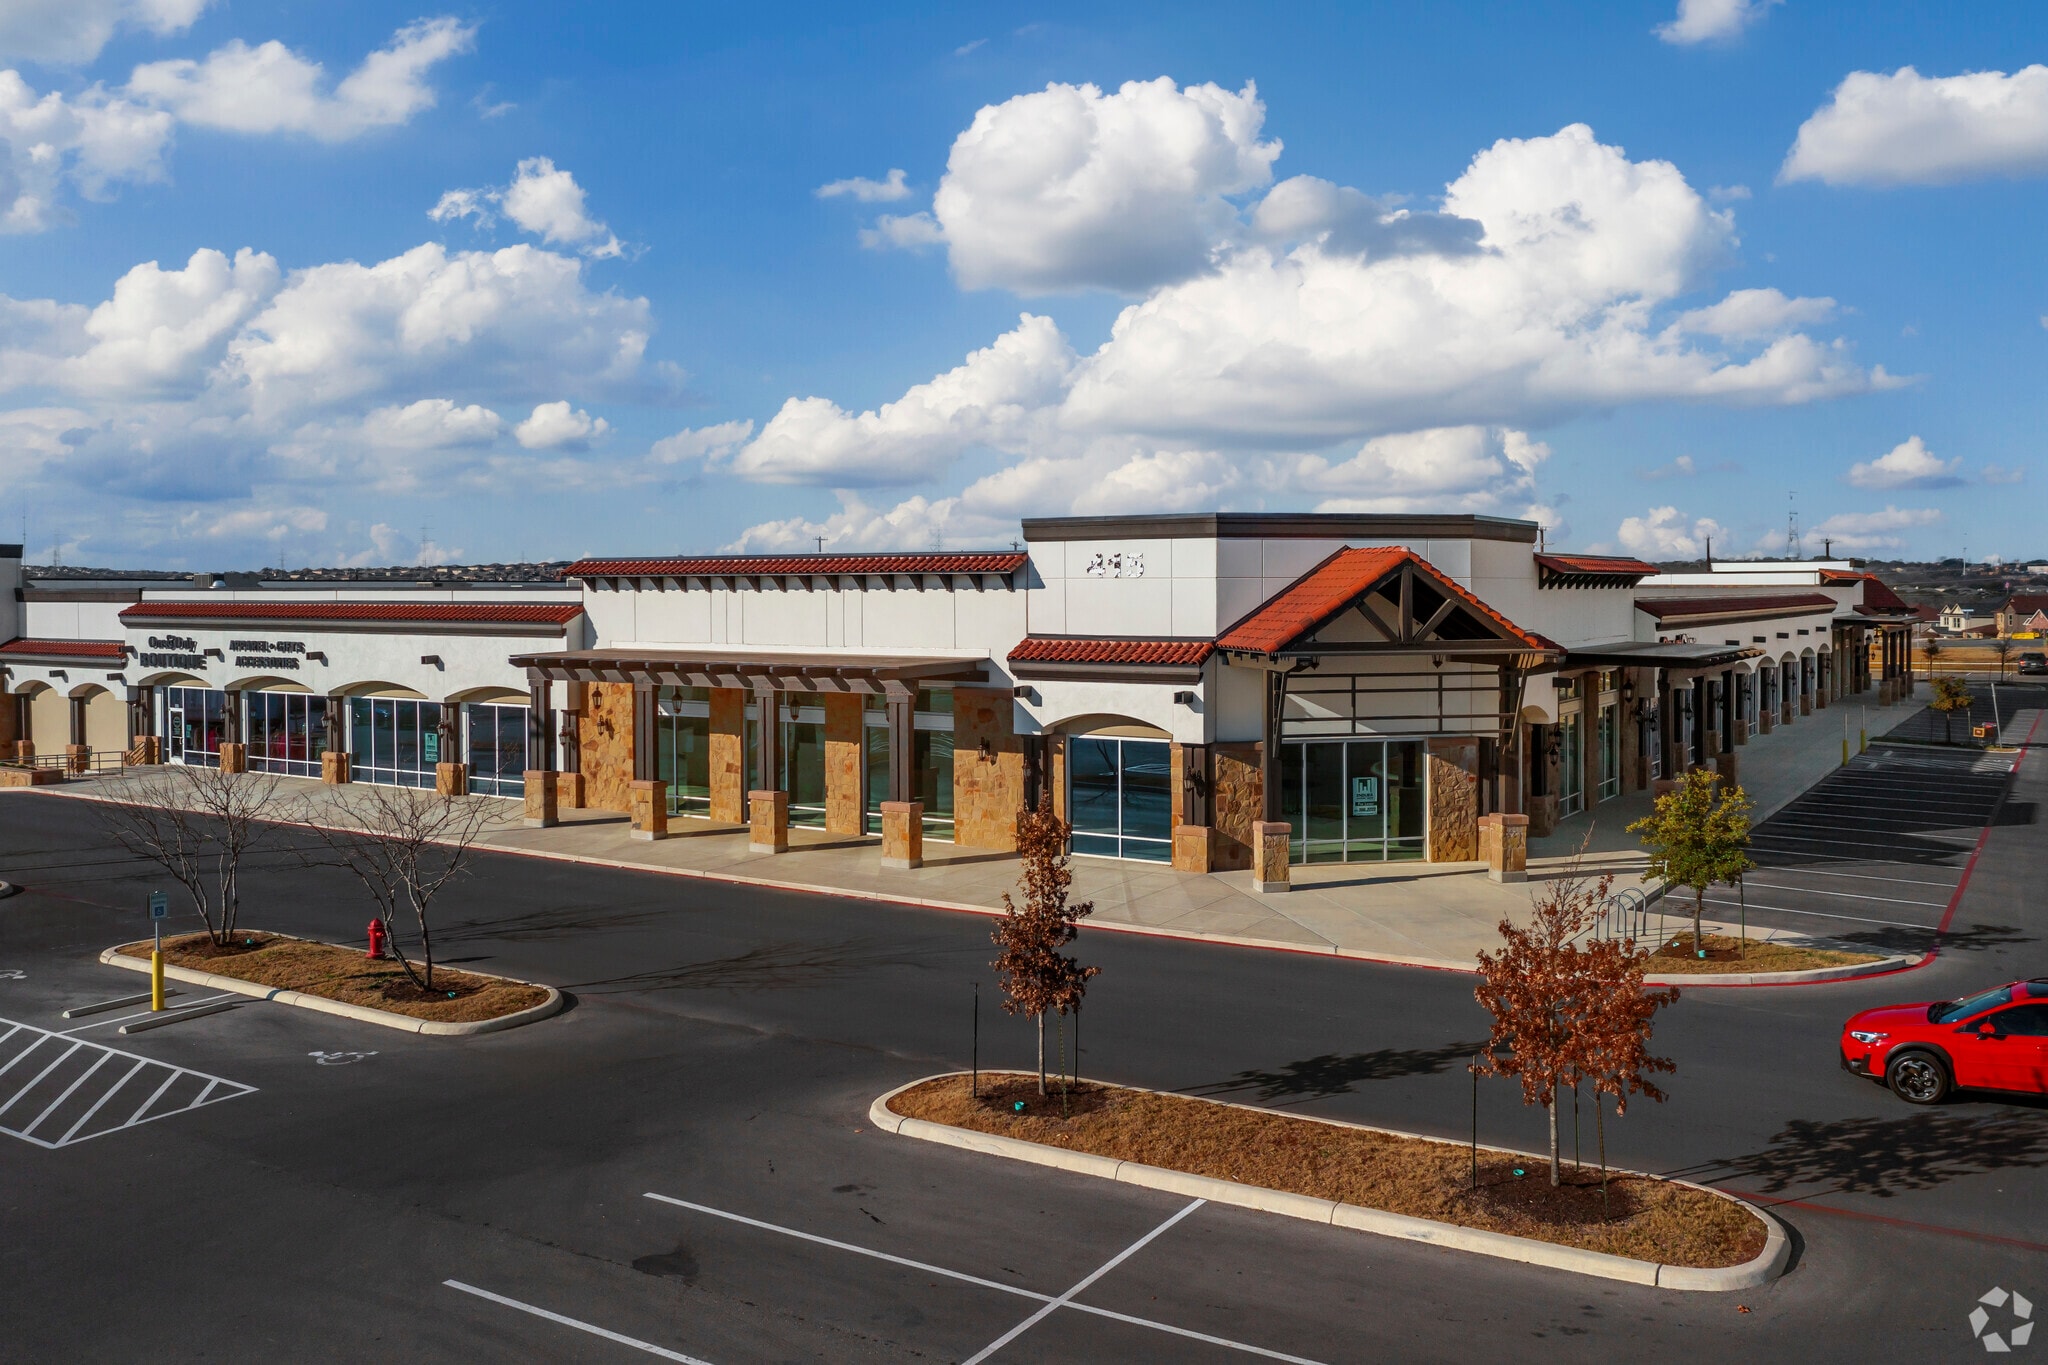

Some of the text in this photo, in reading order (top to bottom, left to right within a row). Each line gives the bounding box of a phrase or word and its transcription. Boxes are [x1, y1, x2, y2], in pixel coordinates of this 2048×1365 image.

[1086, 553, 1145, 578] 415
[229, 640, 306, 654] APPAREL GIFTS
[139, 652, 208, 670] BOUTIQUE
[235, 656, 300, 670] ACCESSORIES
